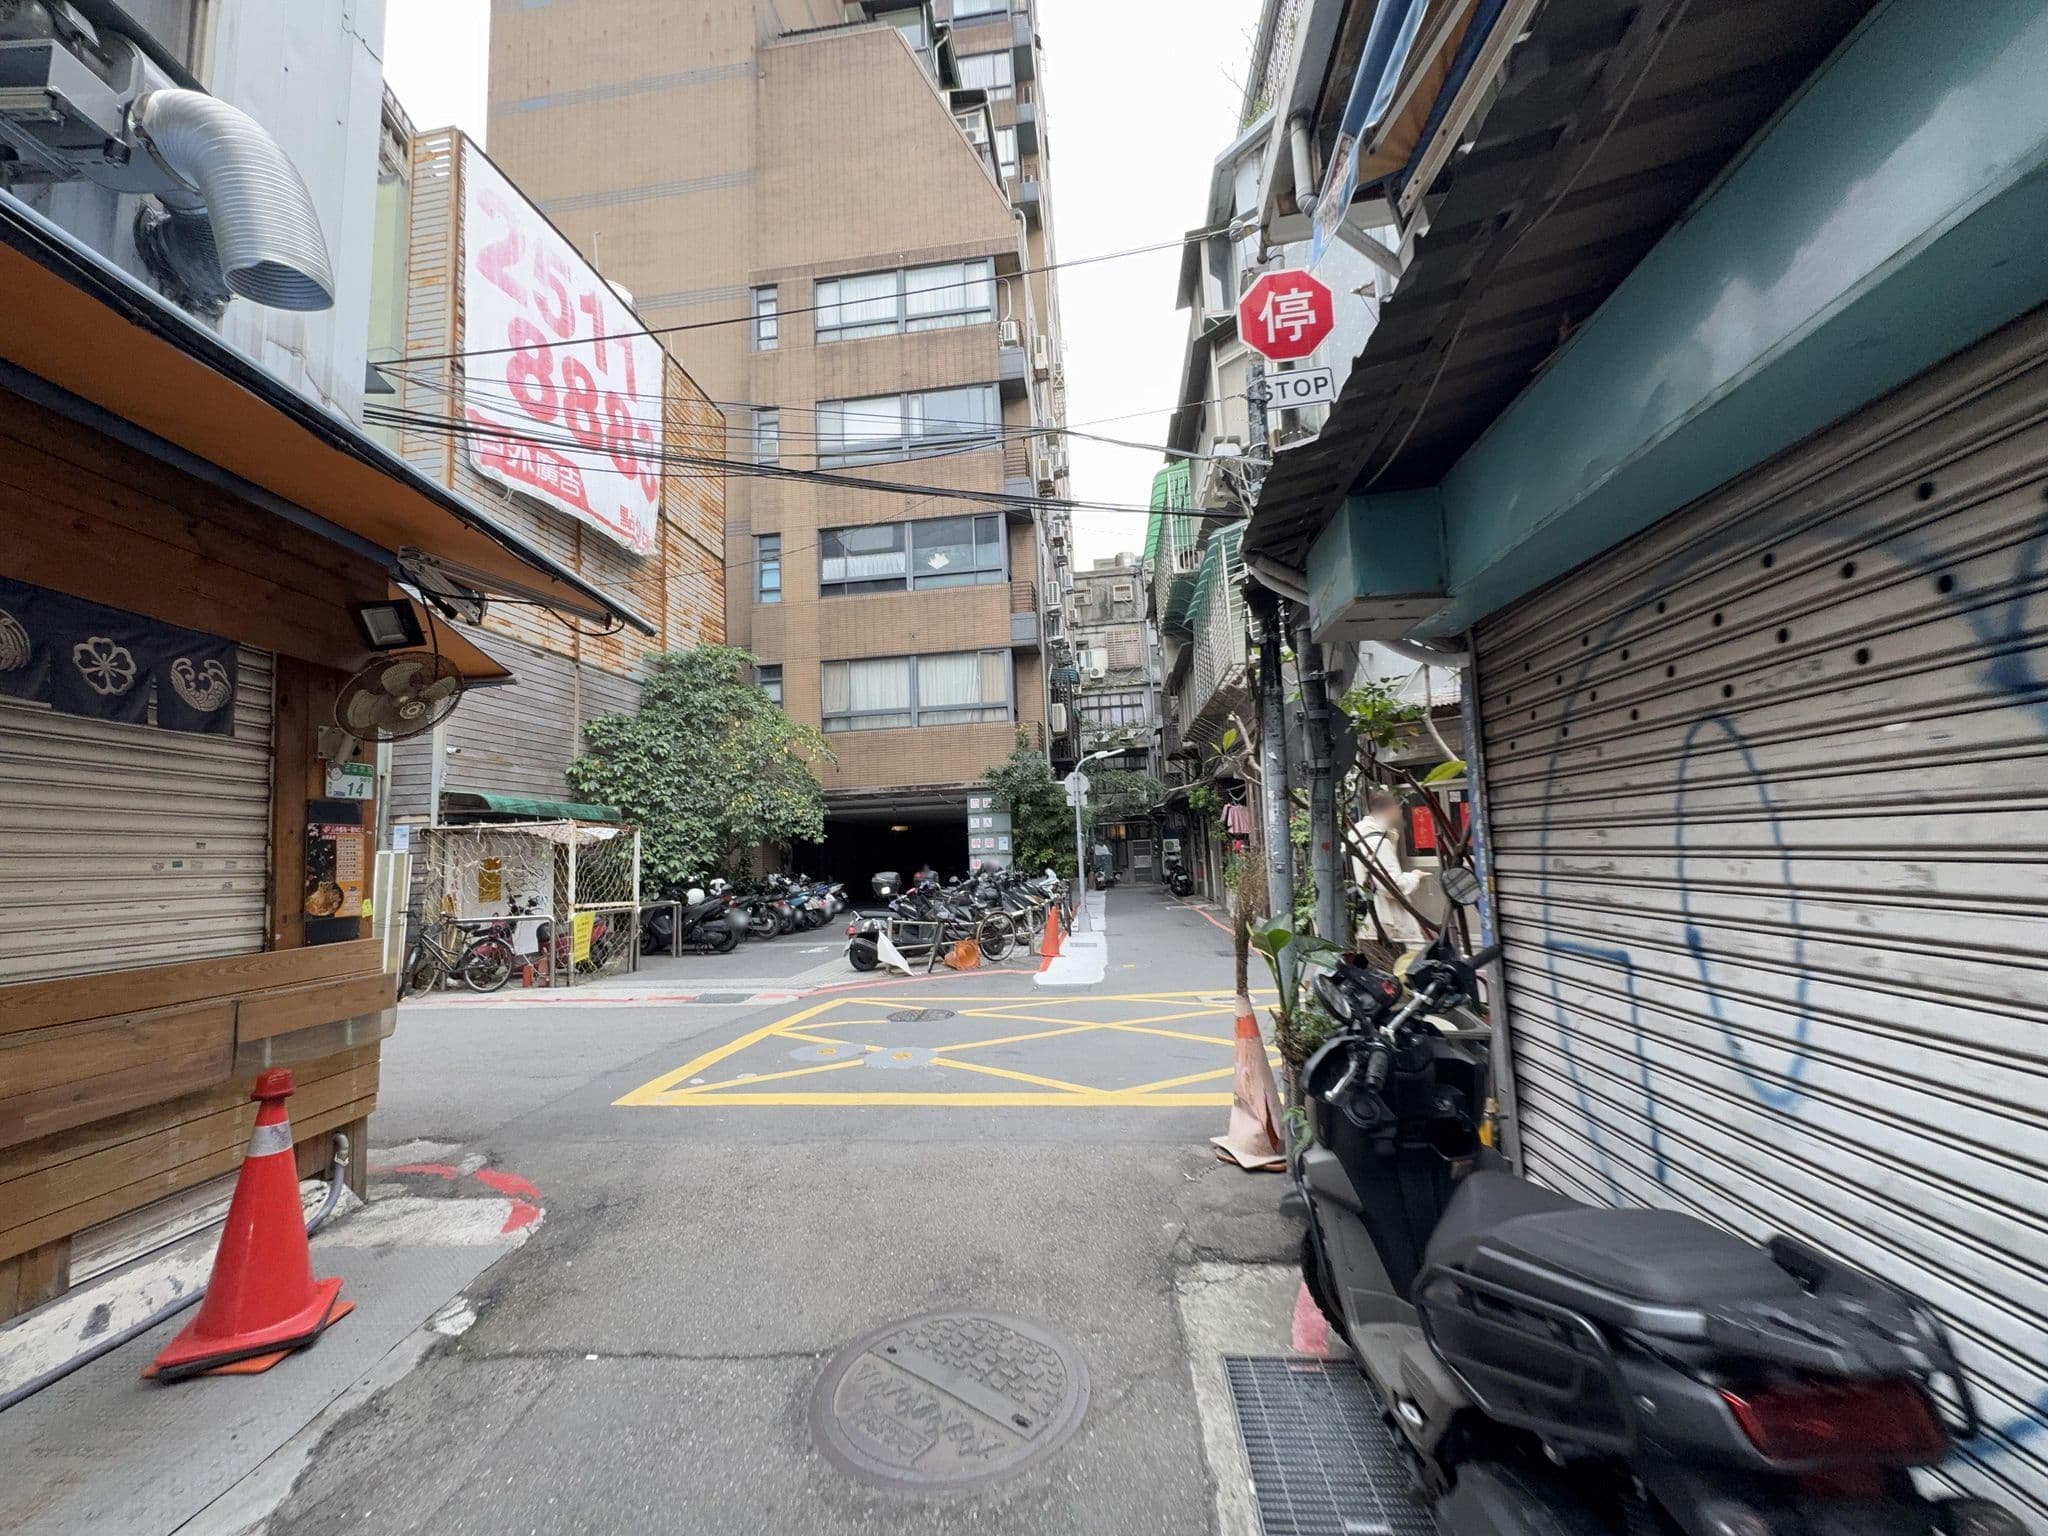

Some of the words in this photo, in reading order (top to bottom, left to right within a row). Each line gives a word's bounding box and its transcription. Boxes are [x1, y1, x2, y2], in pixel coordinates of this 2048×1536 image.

[1258, 287, 1317, 343] 停
[1265, 376, 1329, 400] STOP
[347, 782, 364, 797] 14
